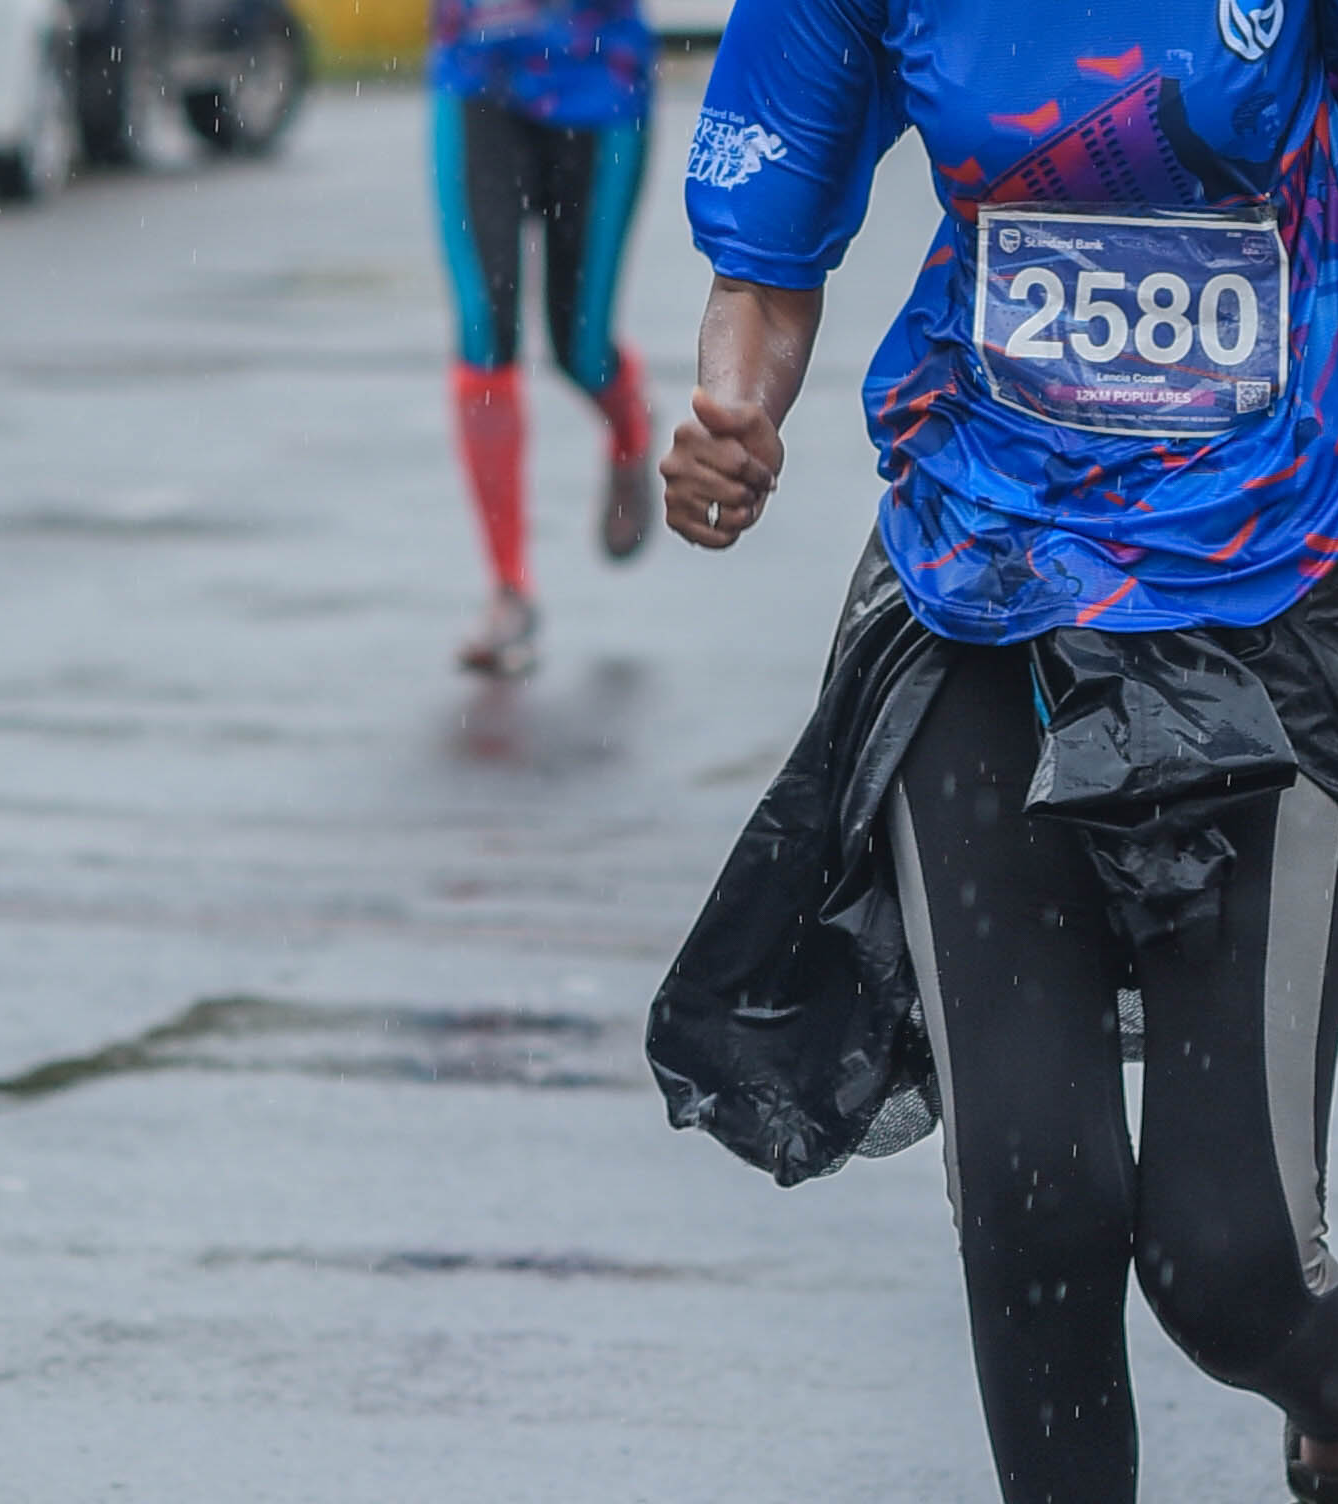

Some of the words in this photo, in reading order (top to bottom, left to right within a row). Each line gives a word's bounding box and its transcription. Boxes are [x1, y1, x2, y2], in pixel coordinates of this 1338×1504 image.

[1024, 235, 1074, 249] Standard
[1075, 238, 1104, 250] Bank
[1005, 267, 1258, 365] 2580
[1076, 389, 1111, 402] 12KM
[1113, 390, 1192, 404] POPULARES
